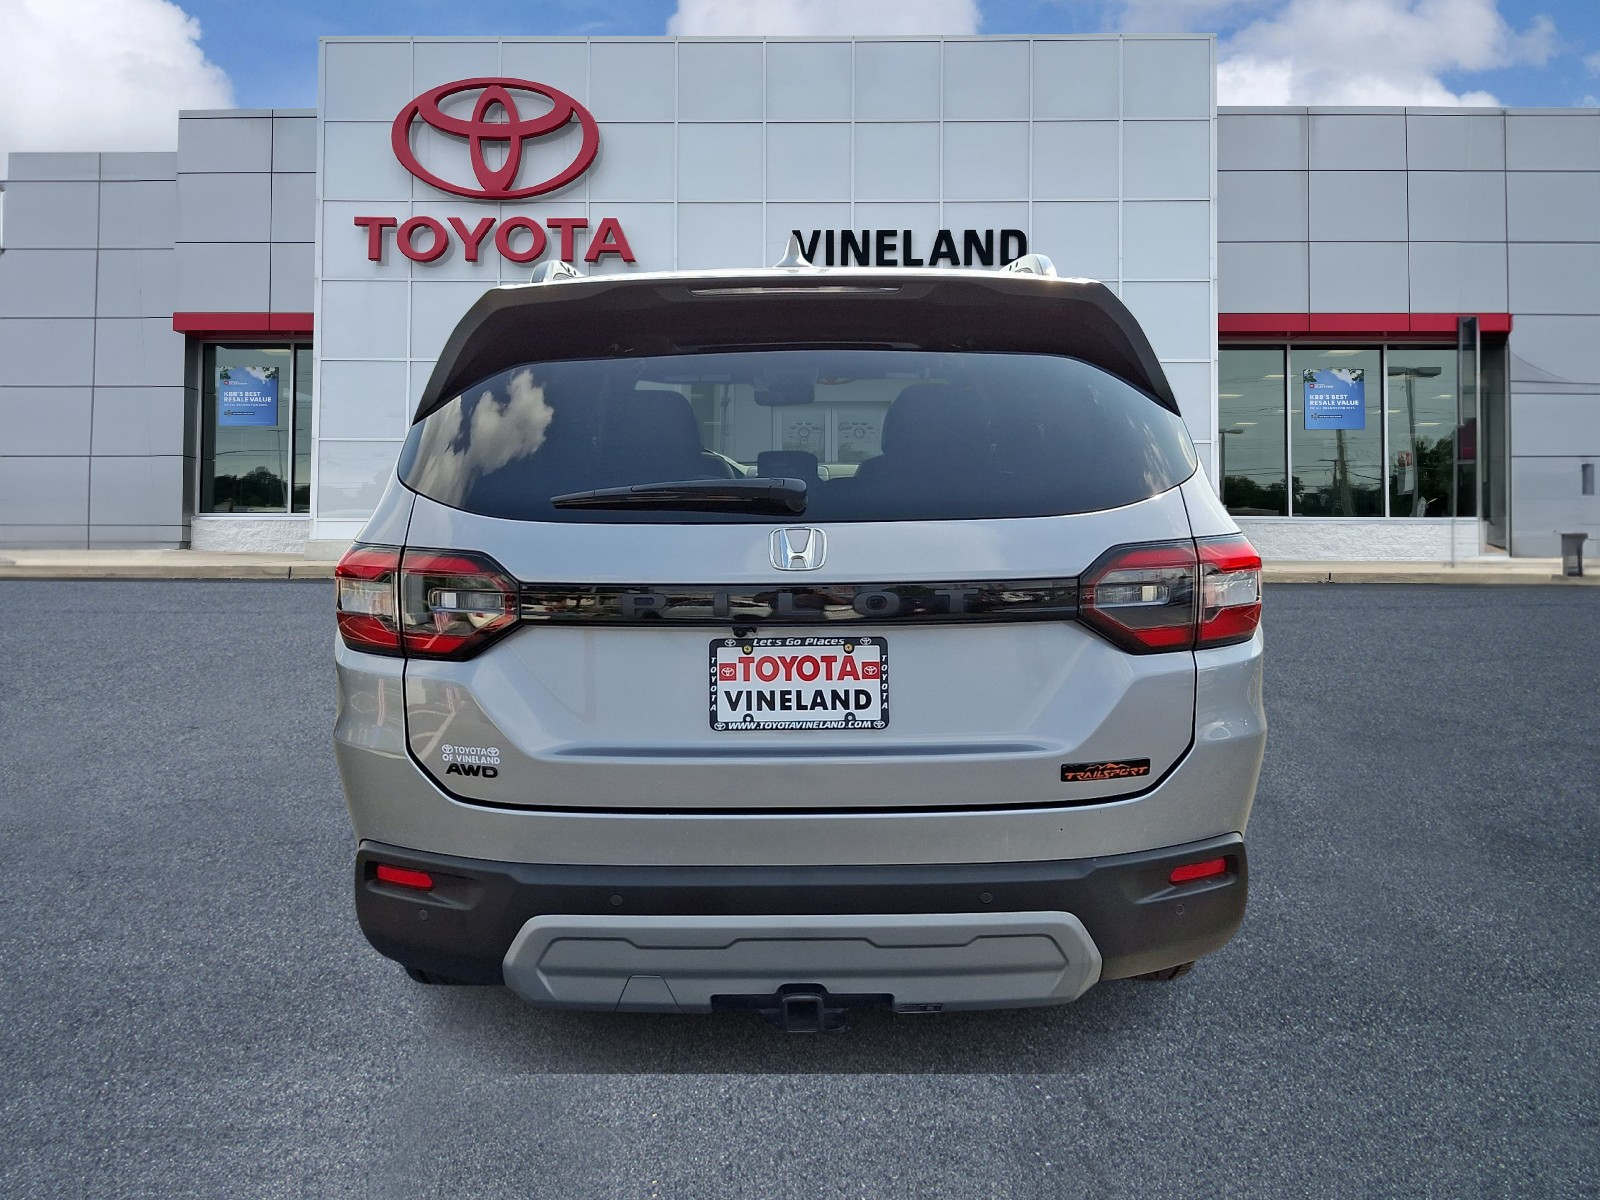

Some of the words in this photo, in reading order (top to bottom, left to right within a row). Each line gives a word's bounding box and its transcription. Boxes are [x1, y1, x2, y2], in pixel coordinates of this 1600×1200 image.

[354, 216, 637, 263] TOYOTA
[792, 229, 1028, 266] VINELAND
[622, 587, 980, 619] PILOT
[752, 638, 782, 647] Let's
[785, 638, 802, 647] Go
[804, 637, 846, 647] Places
[738, 655, 861, 683] TOYOTA
[709, 656, 718, 712] TOYOTA
[880, 654, 889, 710] TOYOTA
[723, 689, 873, 712] VINELAND
[728, 720, 873, 731] WWW.TOYOTAVINELAND.COM
[454, 746, 488, 755] TOYOTA
[456, 755, 500, 764] VINELAND
[446, 763, 498, 778] AWD
[1065, 767, 1148, 780] TRAILSPORT
